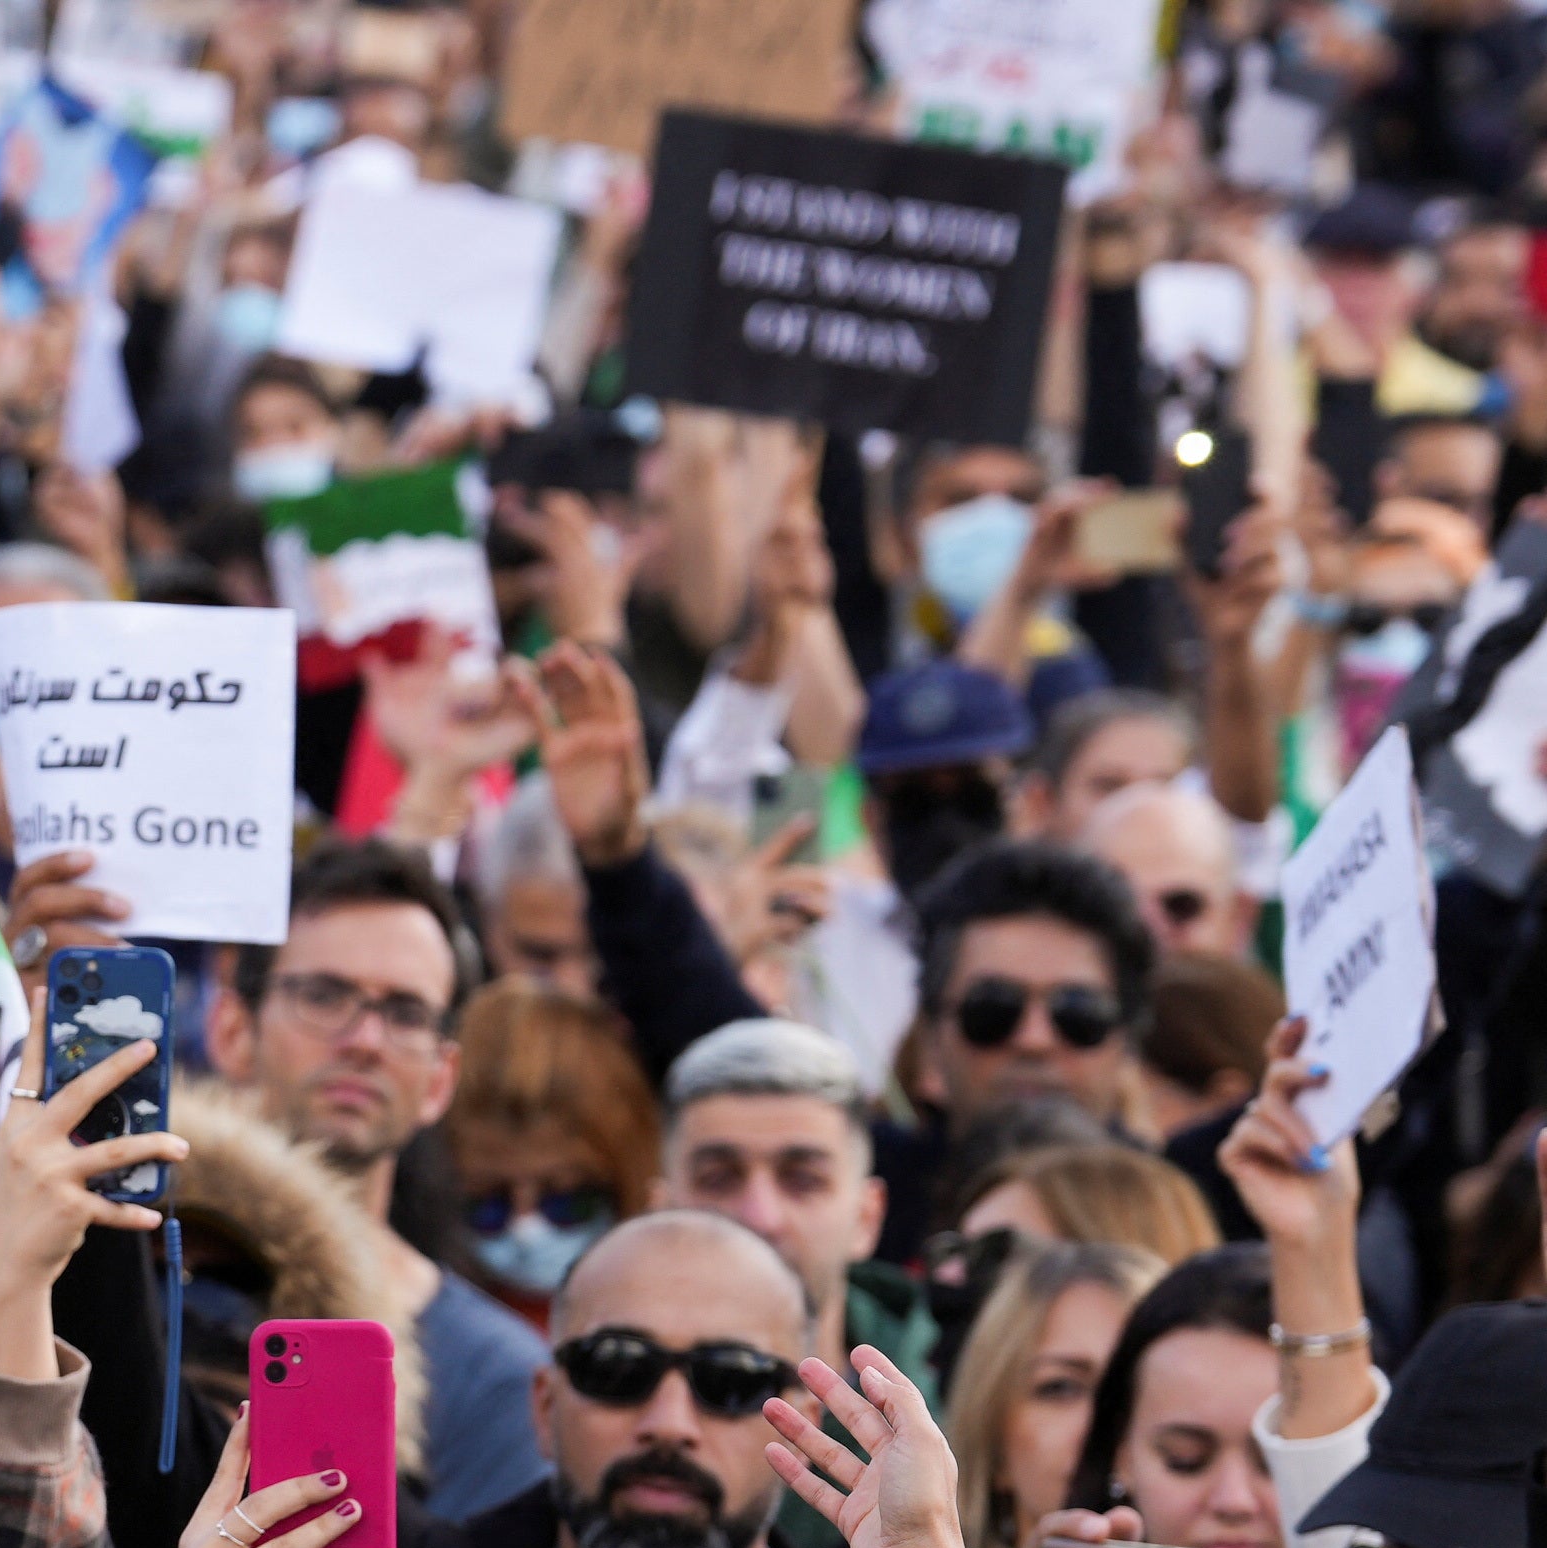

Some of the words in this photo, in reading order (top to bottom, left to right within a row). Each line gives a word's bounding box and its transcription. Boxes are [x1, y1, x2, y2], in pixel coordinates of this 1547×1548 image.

[739, 173, 890, 246] STAND
[892, 196, 1022, 268] WITH
[718, 230, 806, 296] THE
[815, 248, 995, 322] WOMEN
[743, 301, 808, 358] OF
[37, 736, 127, 770] است
[133, 806, 260, 847] Gone
